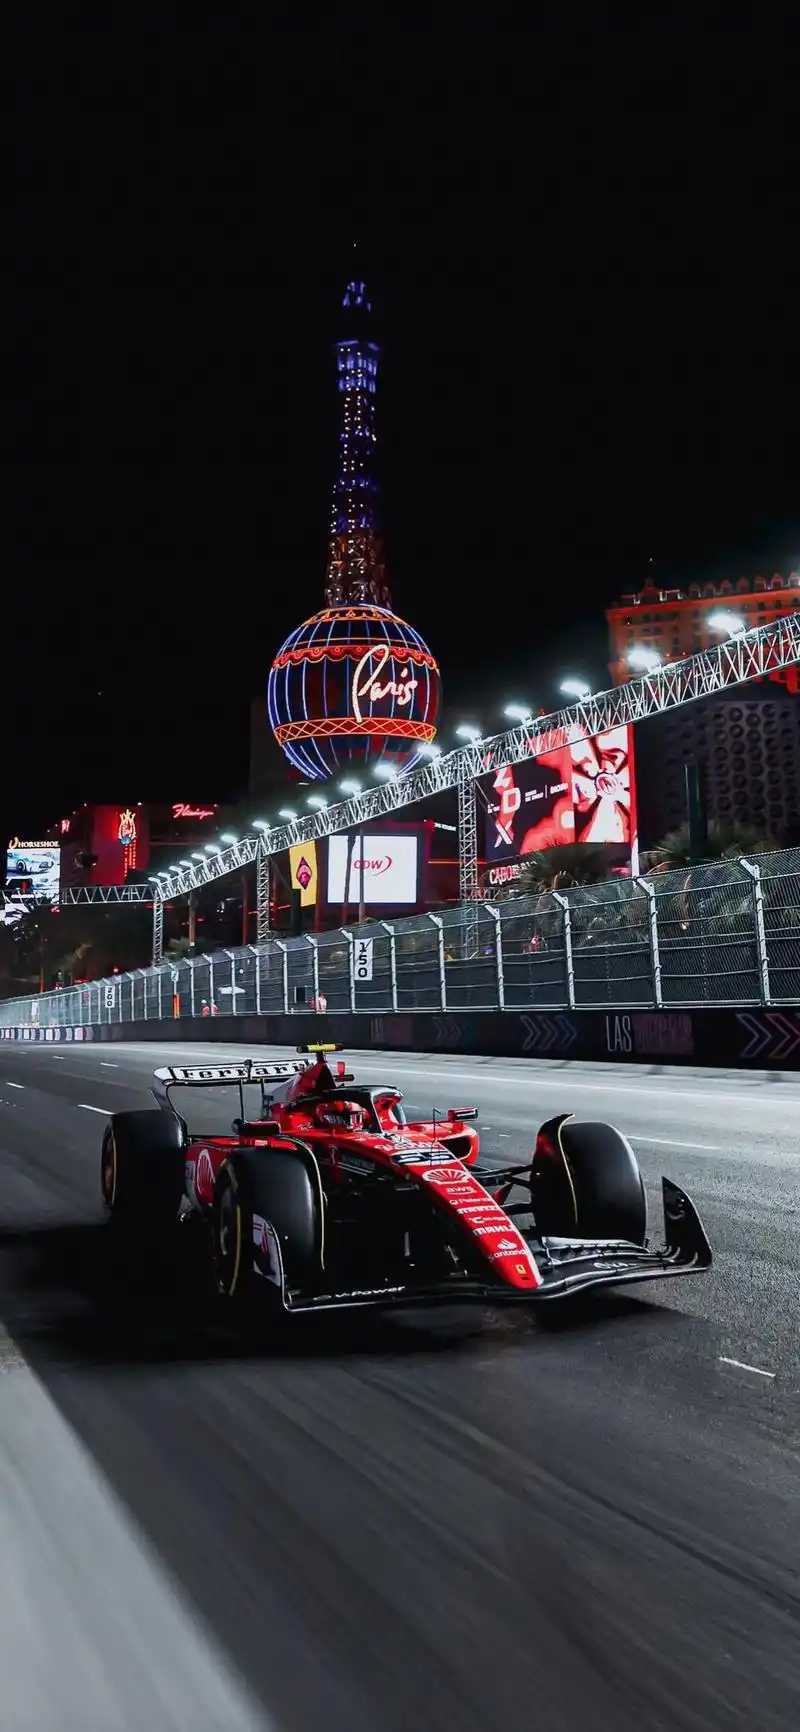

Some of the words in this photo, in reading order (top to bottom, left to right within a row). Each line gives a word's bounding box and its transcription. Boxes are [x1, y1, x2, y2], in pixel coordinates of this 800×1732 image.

[352, 644, 418, 723] Paris
[17, 840, 60, 849] HORSESHOE
[358, 942, 368, 978] 150
[106, 987, 114, 1007] 200
[605, 1015, 632, 1052] LAS
[180, 1063, 302, 1081] Ferrari
